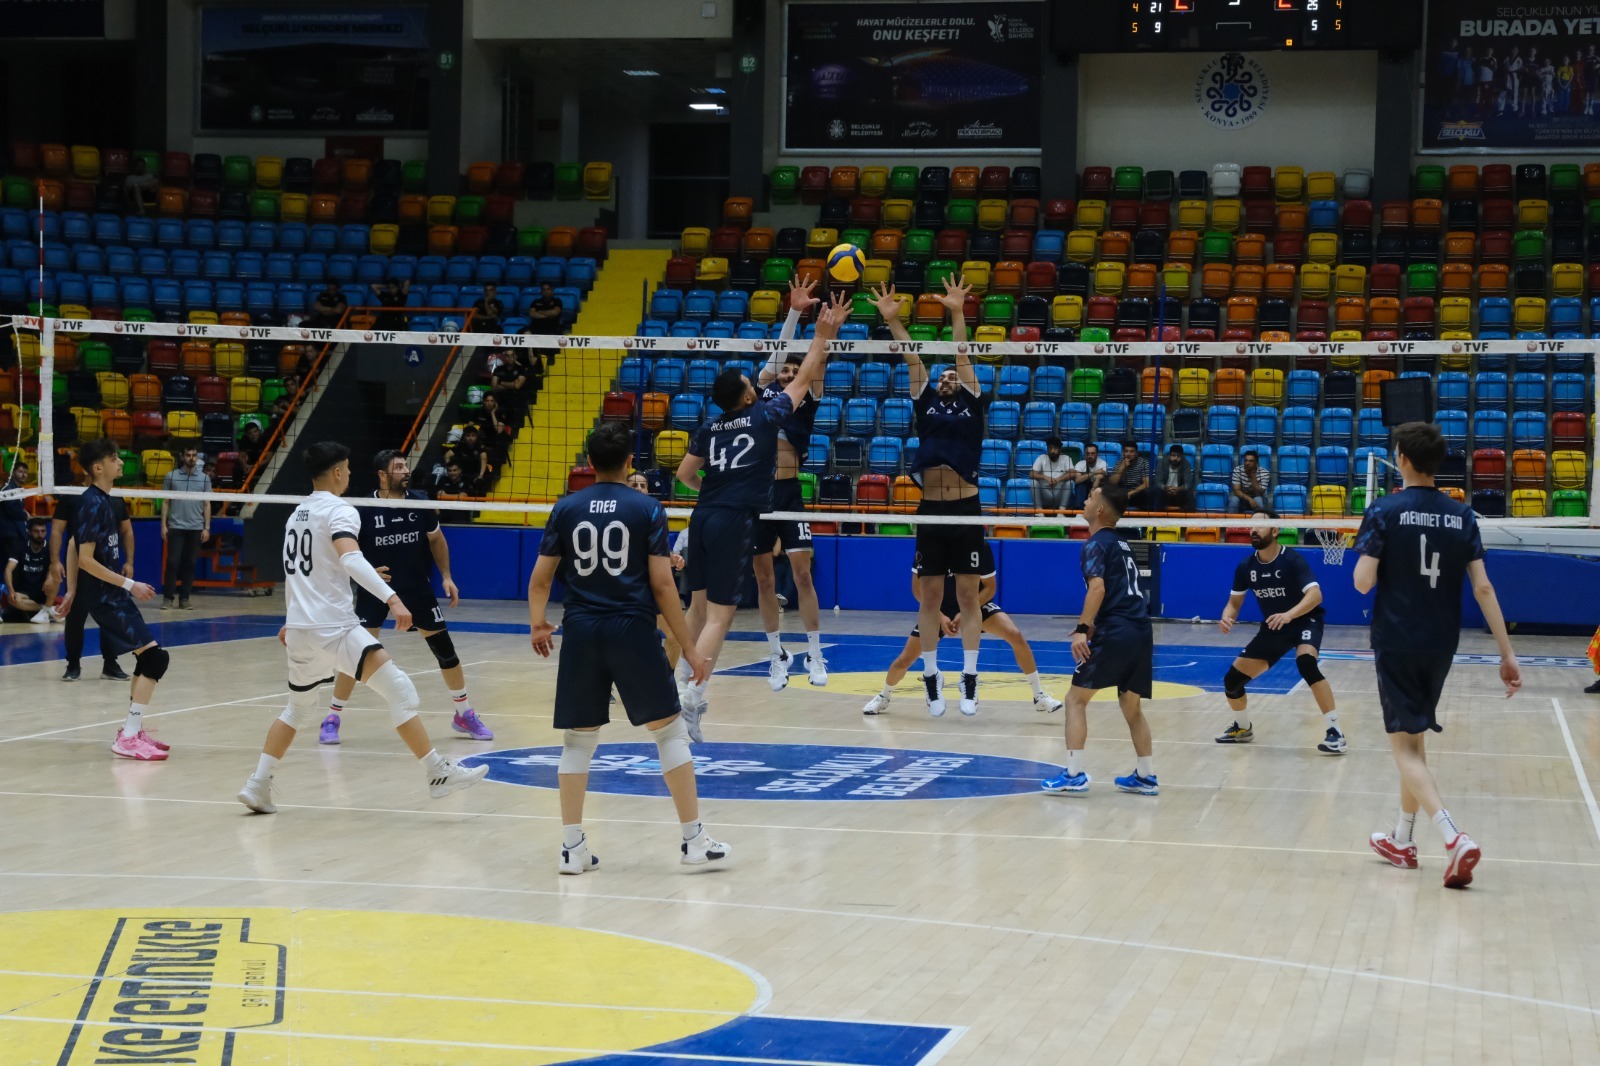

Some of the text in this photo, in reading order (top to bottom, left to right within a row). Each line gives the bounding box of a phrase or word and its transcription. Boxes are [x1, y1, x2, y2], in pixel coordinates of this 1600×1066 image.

[1132, 2, 1162, 13] 4 21
[1497, 7, 1582, 18] SELÇUKLU'NUN
[857, 18, 884, 26] HAYAT
[949, 17, 976, 26] DOLU,
[1311, 19, 1341, 31] 5 5
[1132, 22, 1161, 33] 5 9
[1460, 19, 1558, 37] BURADA
[873, 29, 960, 43] ONU KEŞFET!
[743, 57, 754, 67] B2
[1204, 110, 1234, 127] KONYA
[62, 321, 83, 330] TVF
[124, 323, 145, 333] TVF
[187, 325, 208, 335] TVF
[250, 328, 271, 338] TVF
[311, 330, 332, 340] TVF
[375, 332, 396, 342] TVF
[439, 335, 460, 344] TVF
[503, 336, 525, 346] TVF
[569, 338, 590, 347] TVF
[634, 339, 656, 348] TVF
[698, 340, 720, 349] TVF
[765, 341, 787, 351] TVF
[832, 342, 854, 351] TVF
[900, 343, 923, 352] TVF
[969, 344, 992, 353] TVF
[1036, 344, 1058, 353] TVF
[1106, 344, 1129, 353] TVF
[1177, 344, 1200, 353] TVF
[1248, 344, 1272, 353] TVF
[1320, 344, 1344, 353] TVF
[1390, 343, 1414, 352] TVF
[1464, 343, 1488, 352] TVF
[1539, 342, 1564, 351] TVF
[709, 433, 755, 472] 42
[589, 500, 616, 513] ENES
[374, 515, 385, 528] 11
[1400, 511, 1462, 529] MEHMET CAN
[798, 522, 812, 540] 15
[375, 531, 420, 546] RESPECT
[285, 528, 313, 576] 99
[572, 520, 630, 577] 99
[970, 552, 979, 567] 9
[1420, 533, 1440, 588] 4
[1122, 556, 1143, 598] 12
[1250, 570, 1257, 582] 8
[431, 606, 444, 623] 11
[1301, 629, 1311, 640] 8
[755, 754, 895, 793] SELÇUKLU
[847, 756, 974, 797] BELEDİYESİ
[241, 959, 269, 1008] gayrmenkul
